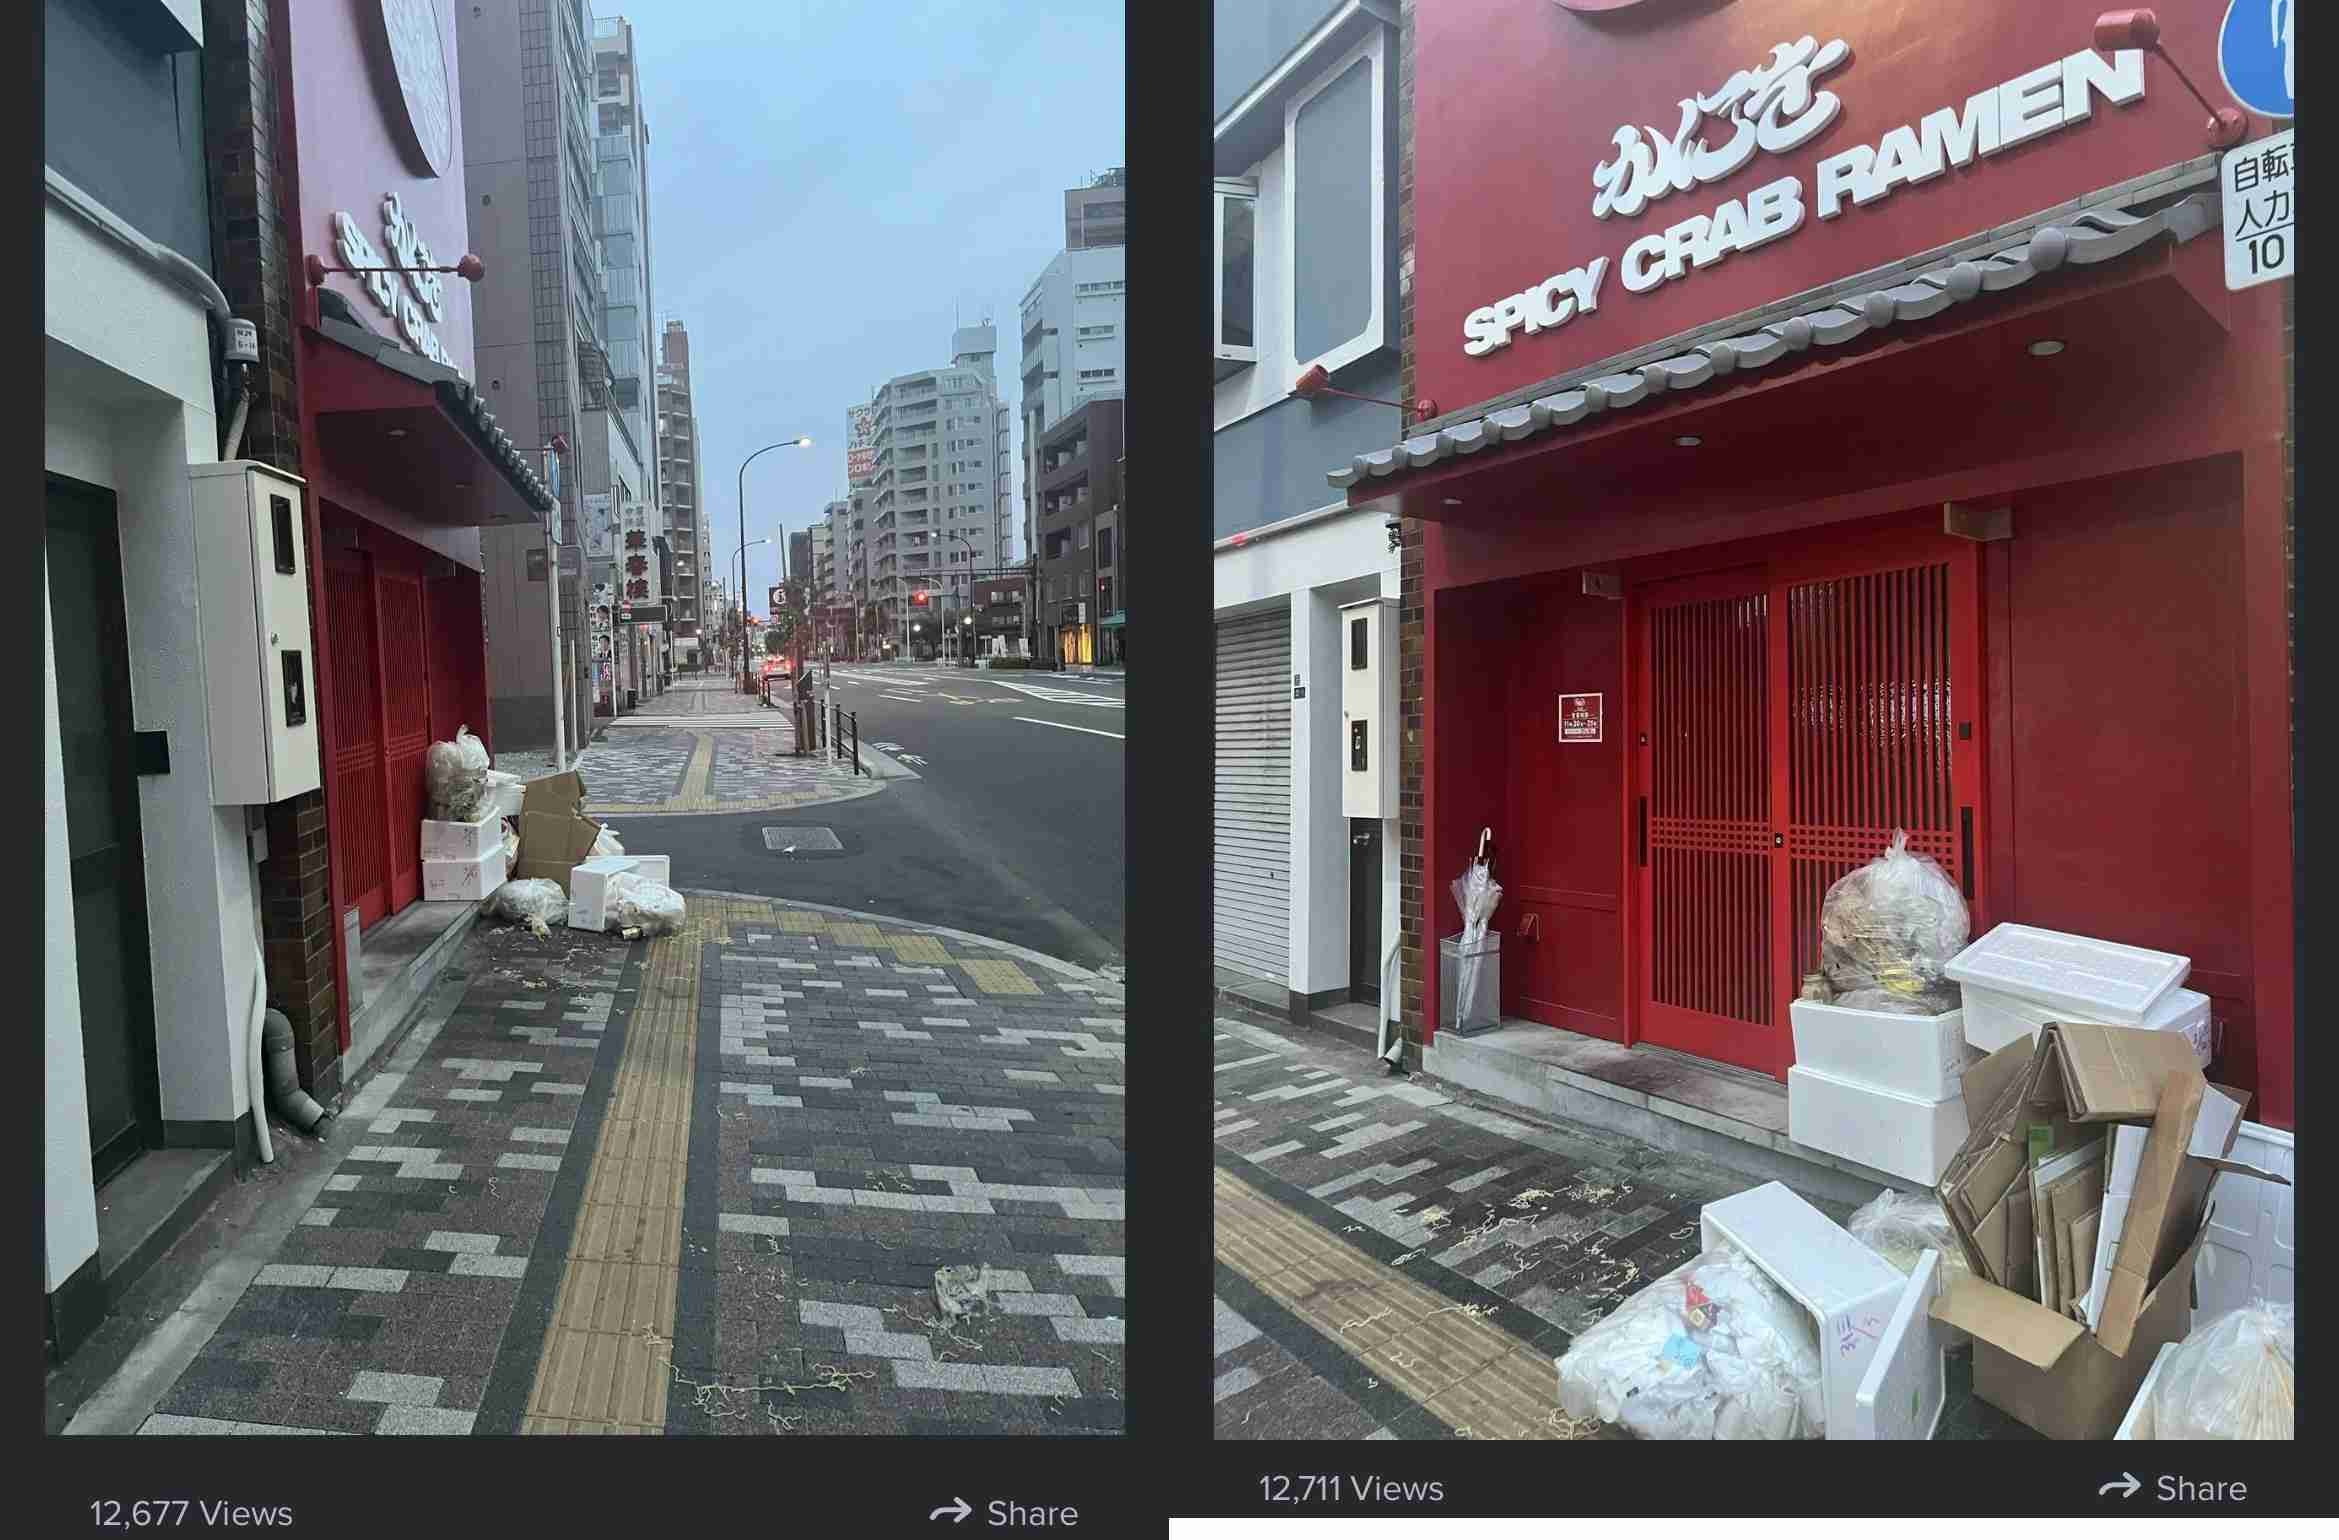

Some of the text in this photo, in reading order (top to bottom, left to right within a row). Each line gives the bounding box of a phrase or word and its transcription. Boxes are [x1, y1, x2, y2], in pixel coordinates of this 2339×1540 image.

[2234, 143, 2295, 193] 自転
[1463, 47, 2147, 357] SPICY CRAB RAMEN
[2234, 189, 2295, 237] 人力
[2248, 233, 2286, 275] 10
